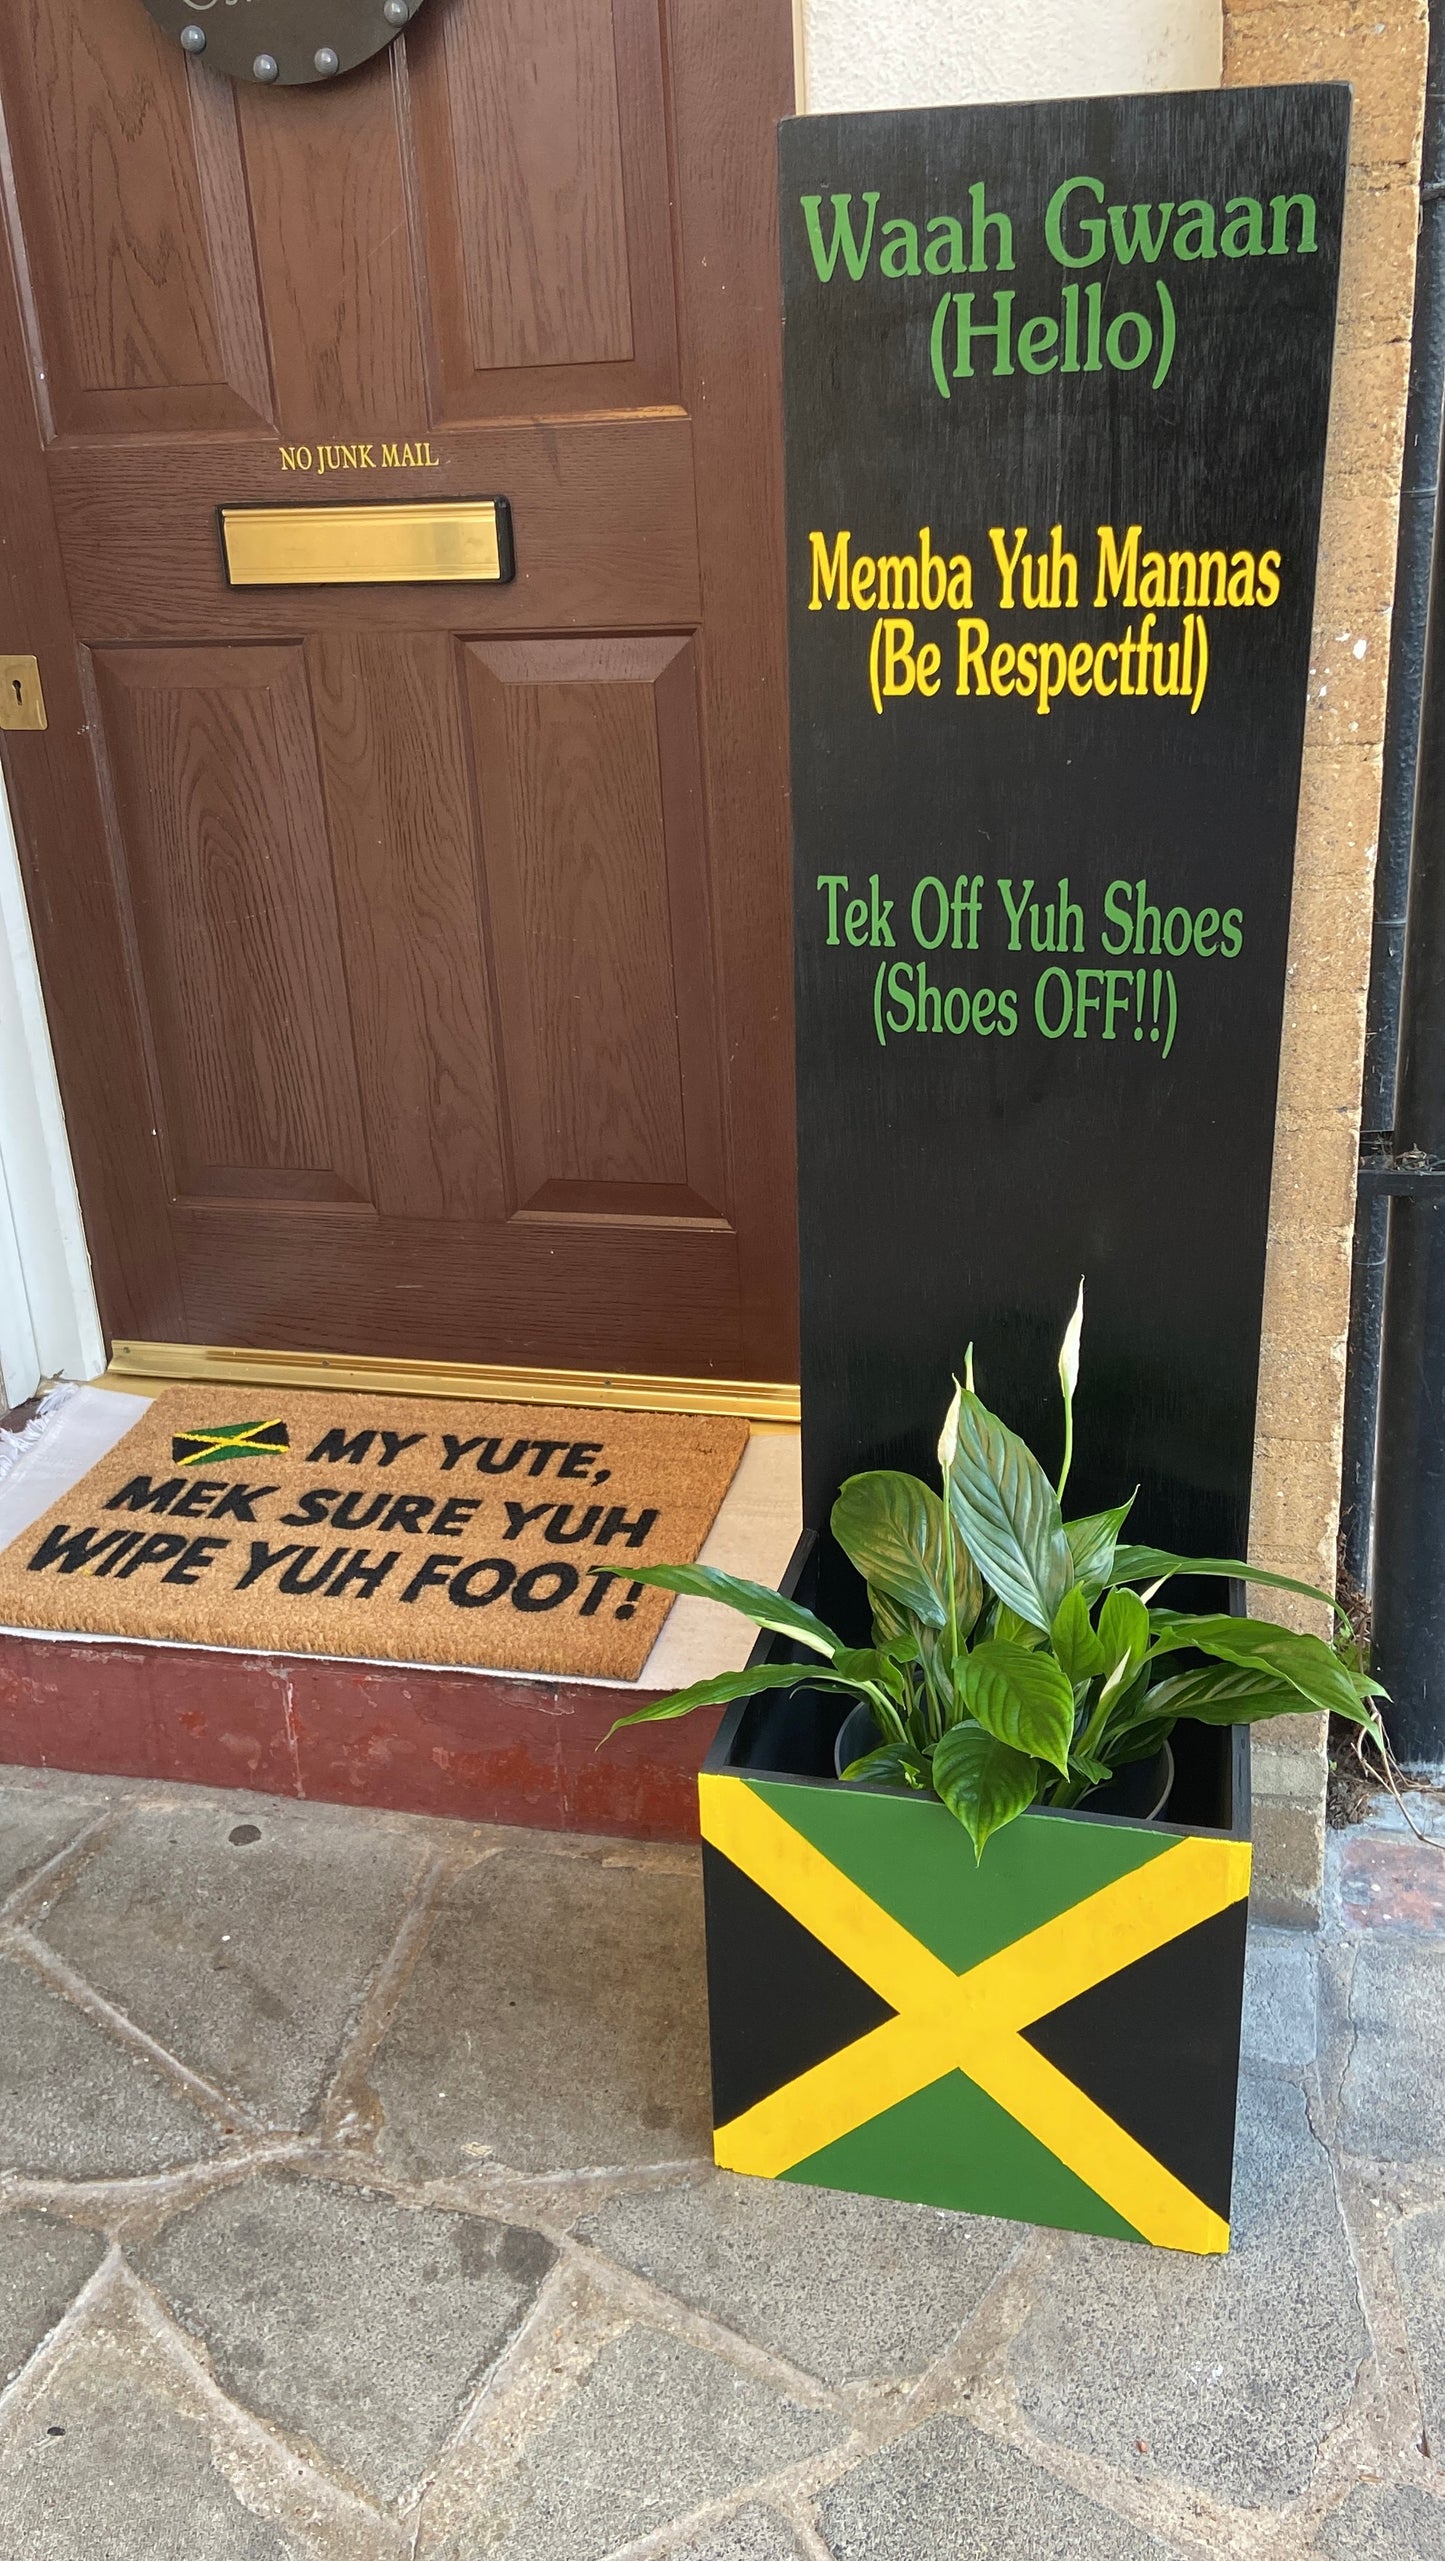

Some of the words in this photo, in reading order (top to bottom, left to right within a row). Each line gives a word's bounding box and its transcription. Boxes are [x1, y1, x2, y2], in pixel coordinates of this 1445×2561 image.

[800, 181, 1017, 282] Waah
[1045, 174, 1317, 269] Gwaan
[929, 278, 1177, 400] (Hello)
[278, 444, 313, 471] NO
[316, 443, 377, 475] JUNK
[381, 441, 440, 468] MAIL
[807, 526, 974, 612] Memba
[988, 524, 1079, 610] Yuh
[1093, 525, 1282, 609] Mannas
[869, 617, 941, 714] (Be
[955, 612, 1209, 716] Respectful)
[816, 873, 896, 948] Tek
[910, 874, 985, 950] Off
[996, 877, 1085, 953] Yuh
[1101, 879, 1244, 958] Shoes
[873, 960, 1018, 1046] (Shoes
[1034, 966, 1178, 1059] OFF!!)
[307, 1428, 427, 1467] MY
[440, 1434, 611, 1486] YUTE,
[104, 1475, 279, 1523] MEK
[280, 1488, 482, 1537] SURE
[502, 1501, 659, 1548] YUH
[27, 1524, 230, 1586] WIPE
[234, 1541, 401, 1599] YUH
[399, 1554, 646, 1620] FOOT!
